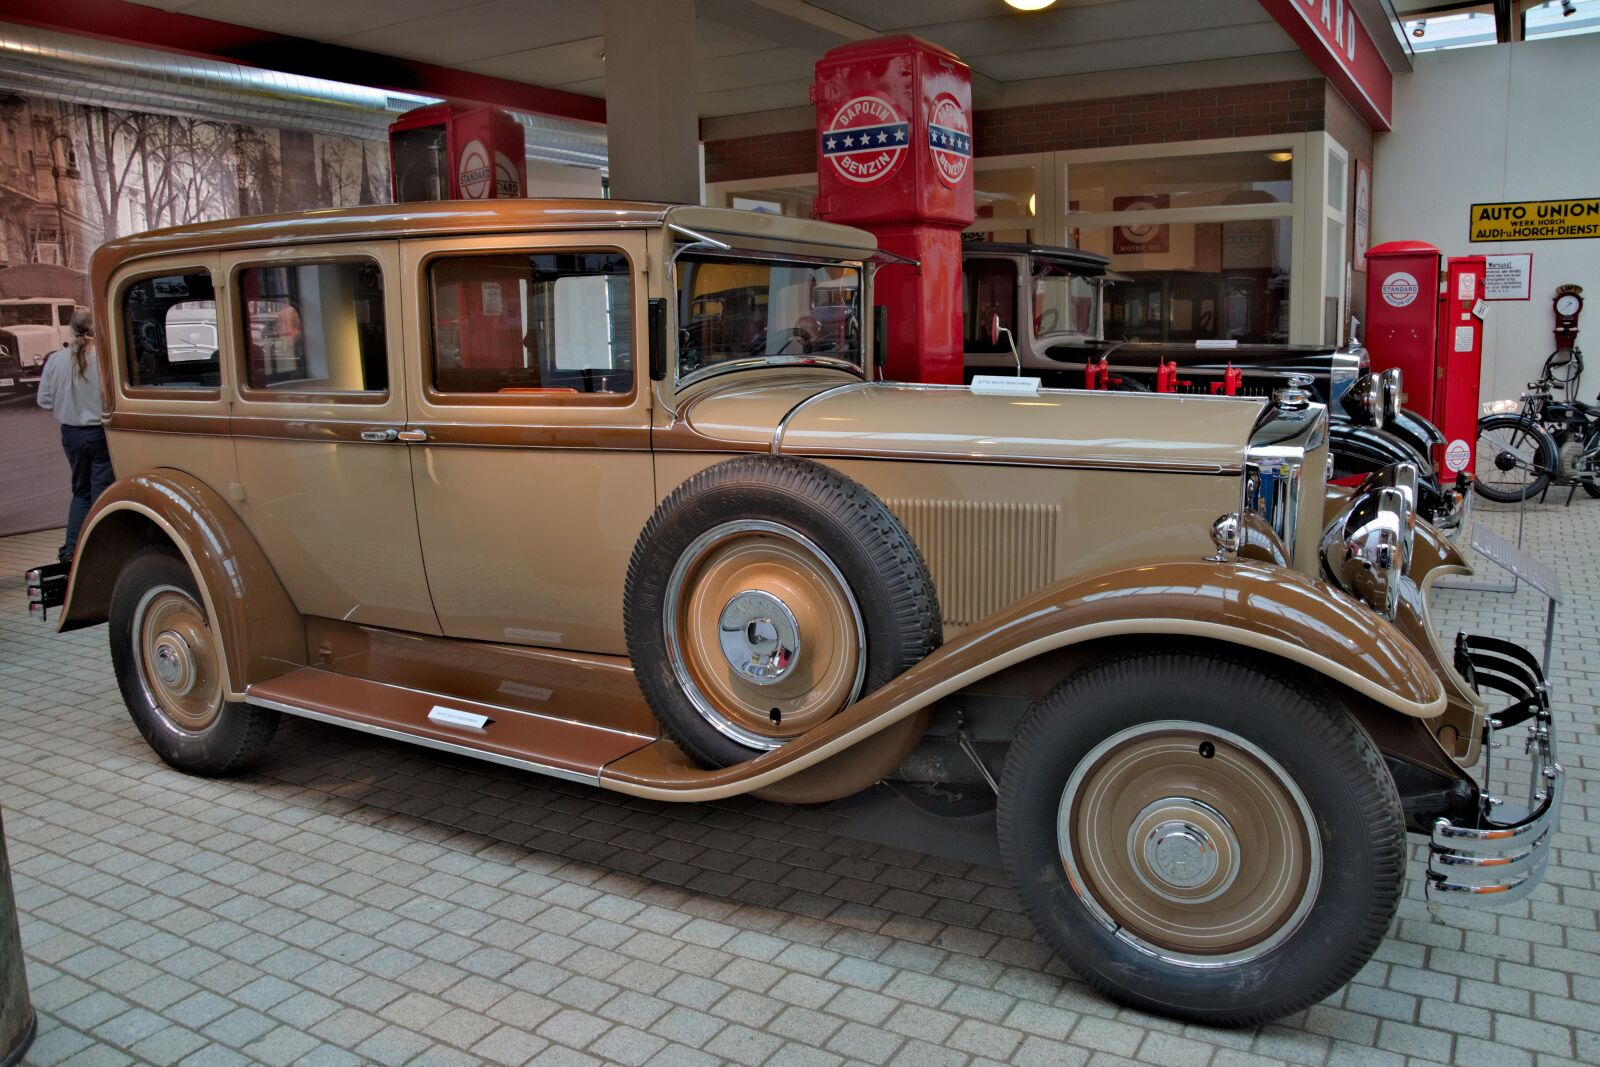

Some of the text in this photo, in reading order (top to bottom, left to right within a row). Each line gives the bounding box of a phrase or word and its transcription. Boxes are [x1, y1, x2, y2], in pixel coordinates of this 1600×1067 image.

[838, 101, 890, 126] DAPOLIN
[840, 152, 891, 175] BENZIN
[939, 153, 964, 176] BENZIN
[460, 168, 491, 185] STANDARD
[1479, 203, 1600, 221] AUTO UNION
[1538, 218, 1566, 226] HORCH
[1382, 285, 1418, 293] STANDARD
[1385, 294, 1405, 306] MOTOR
